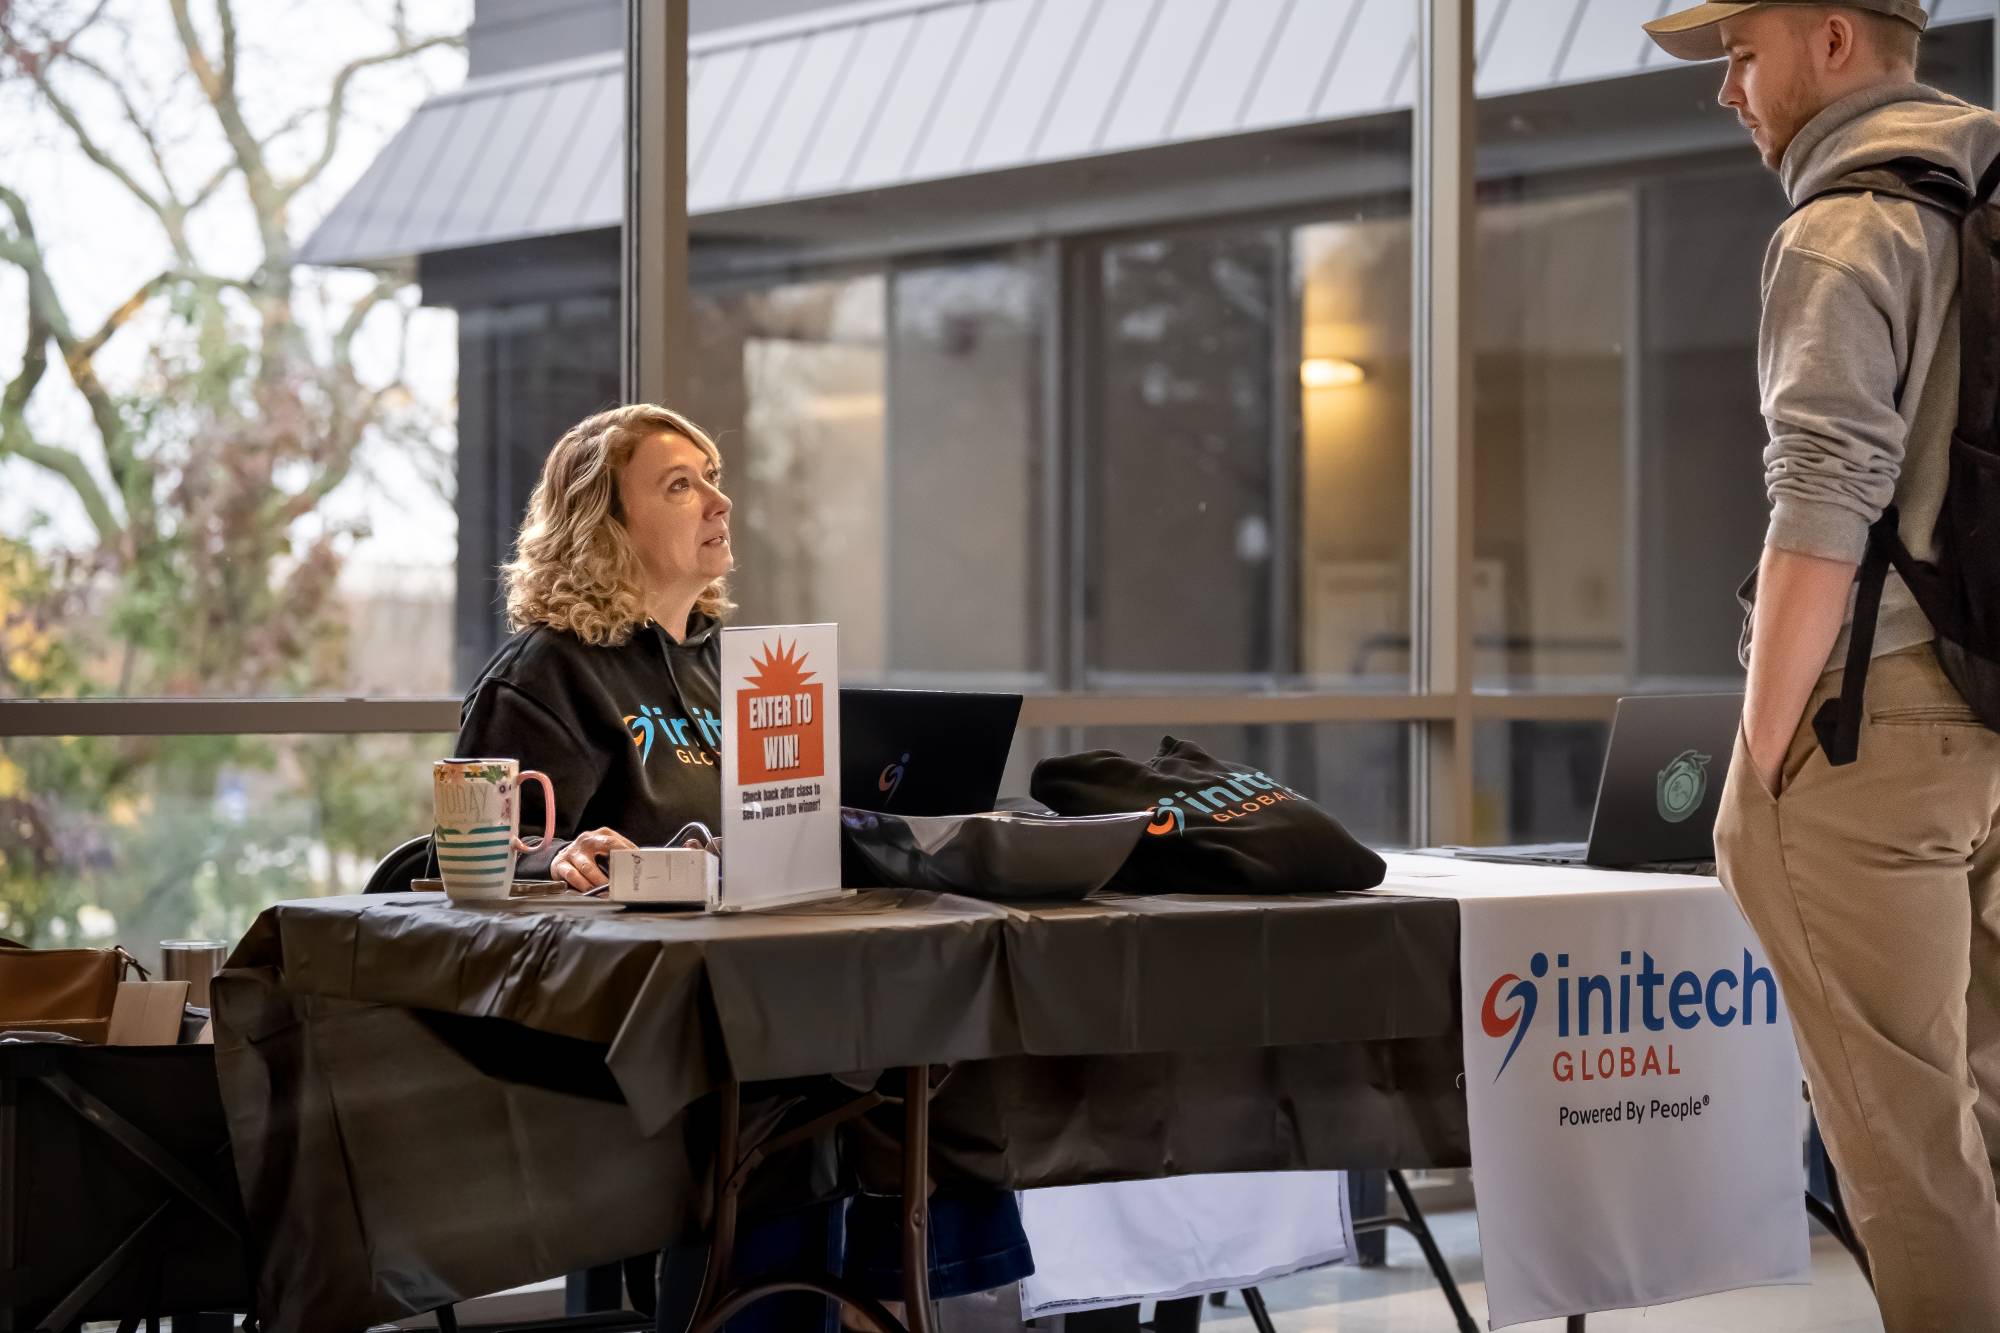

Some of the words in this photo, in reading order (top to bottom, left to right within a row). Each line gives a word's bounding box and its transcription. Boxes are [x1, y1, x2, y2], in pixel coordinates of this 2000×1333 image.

[652, 706, 722, 747] init
[749, 695, 792, 730] ENTER
[795, 693, 813, 726] TO
[763, 734, 800, 771] WIN!
[742, 790, 762, 804] Check
[763, 787, 779, 801] back
[780, 785, 795, 799] after
[797, 783, 813, 797] class
[814, 782, 820, 796] to
[761, 806, 774, 820] you
[775, 804, 785, 817] are
[786, 802, 797, 816] the
[798, 798, 820, 813] winner!
[1174, 771, 1282, 814] init
[1557, 947, 1778, 1038] initech
[1553, 1045, 1681, 1083] GLOBAL
[1560, 1101, 1621, 1126] Powered
[1626, 1101, 1645, 1124] By
